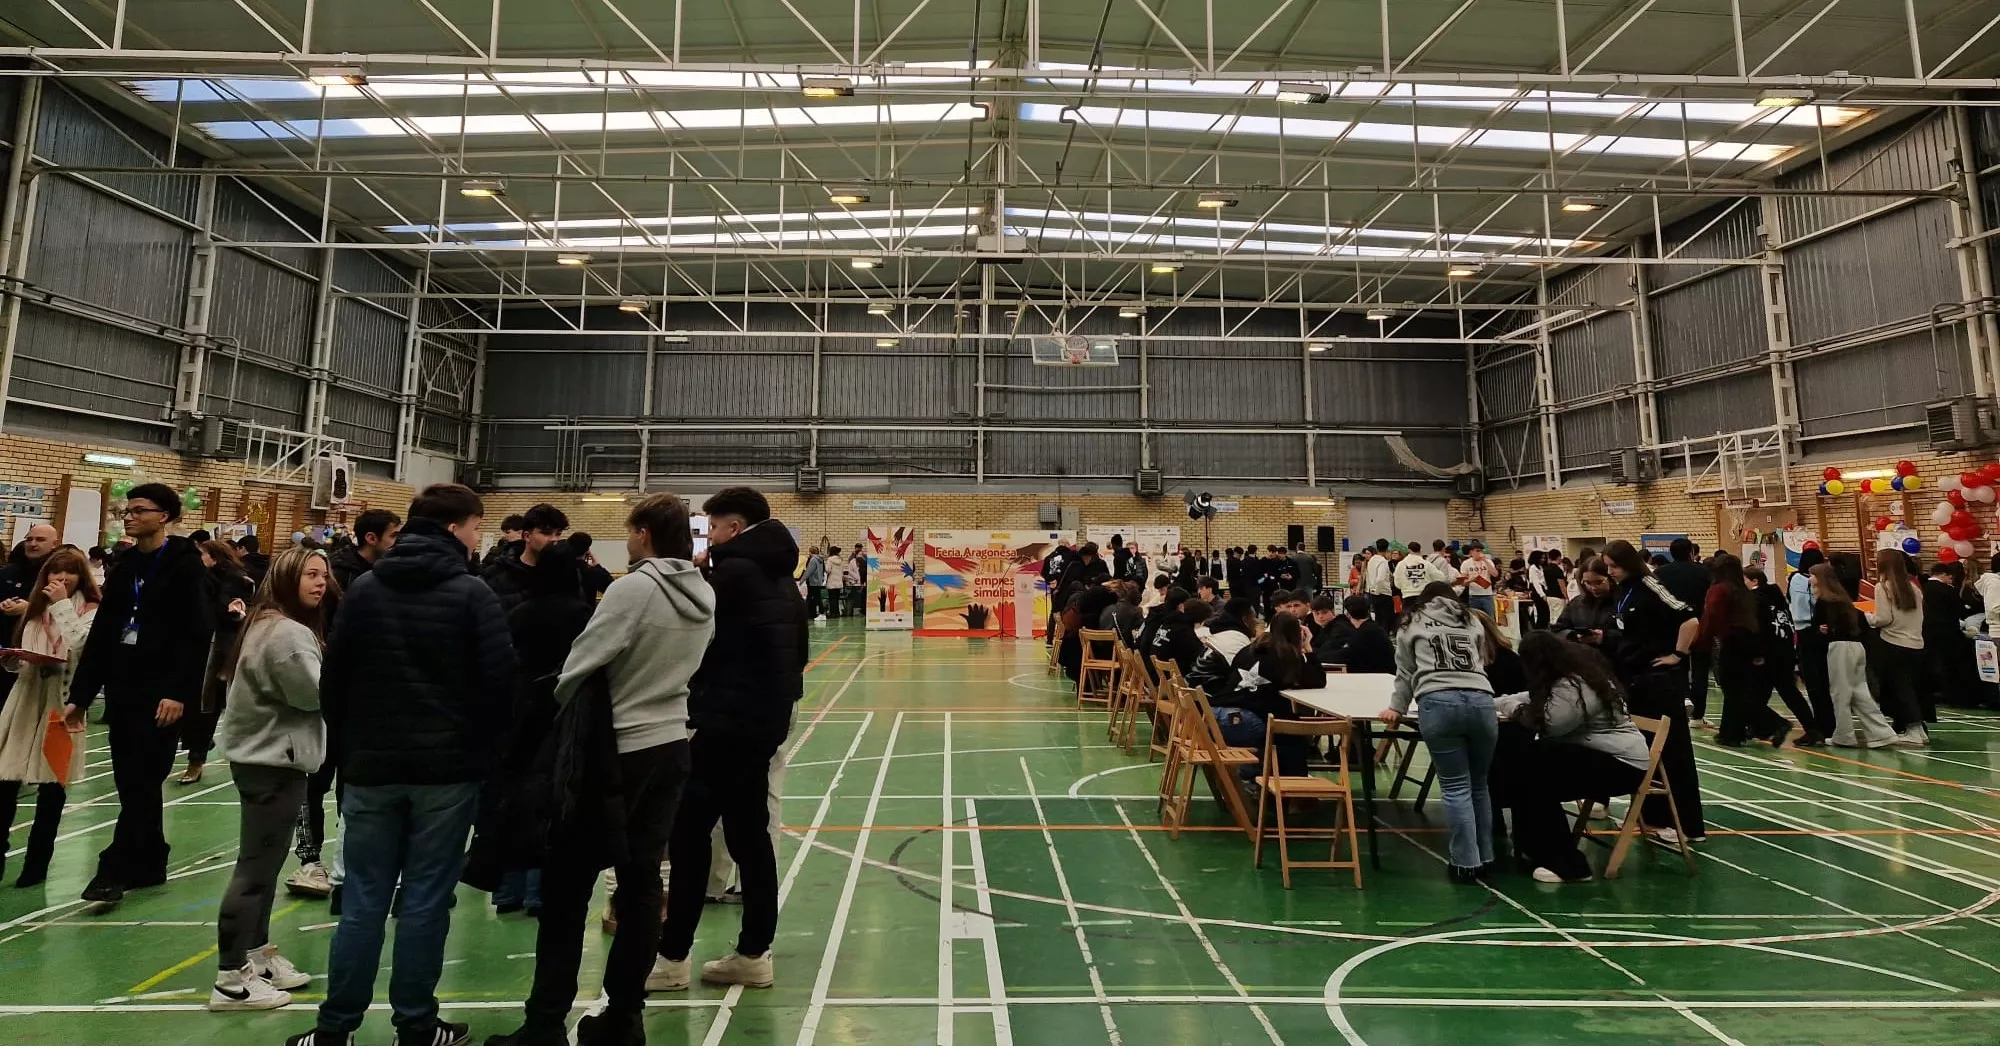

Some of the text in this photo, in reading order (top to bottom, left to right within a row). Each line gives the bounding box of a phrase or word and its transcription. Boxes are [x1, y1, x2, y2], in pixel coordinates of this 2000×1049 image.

[935, 546, 1017, 560] Feria Aragonesa
[974, 577, 1015, 588] empres
[973, 587, 1015, 598] simulad
[1428, 633, 1475, 672] 15
